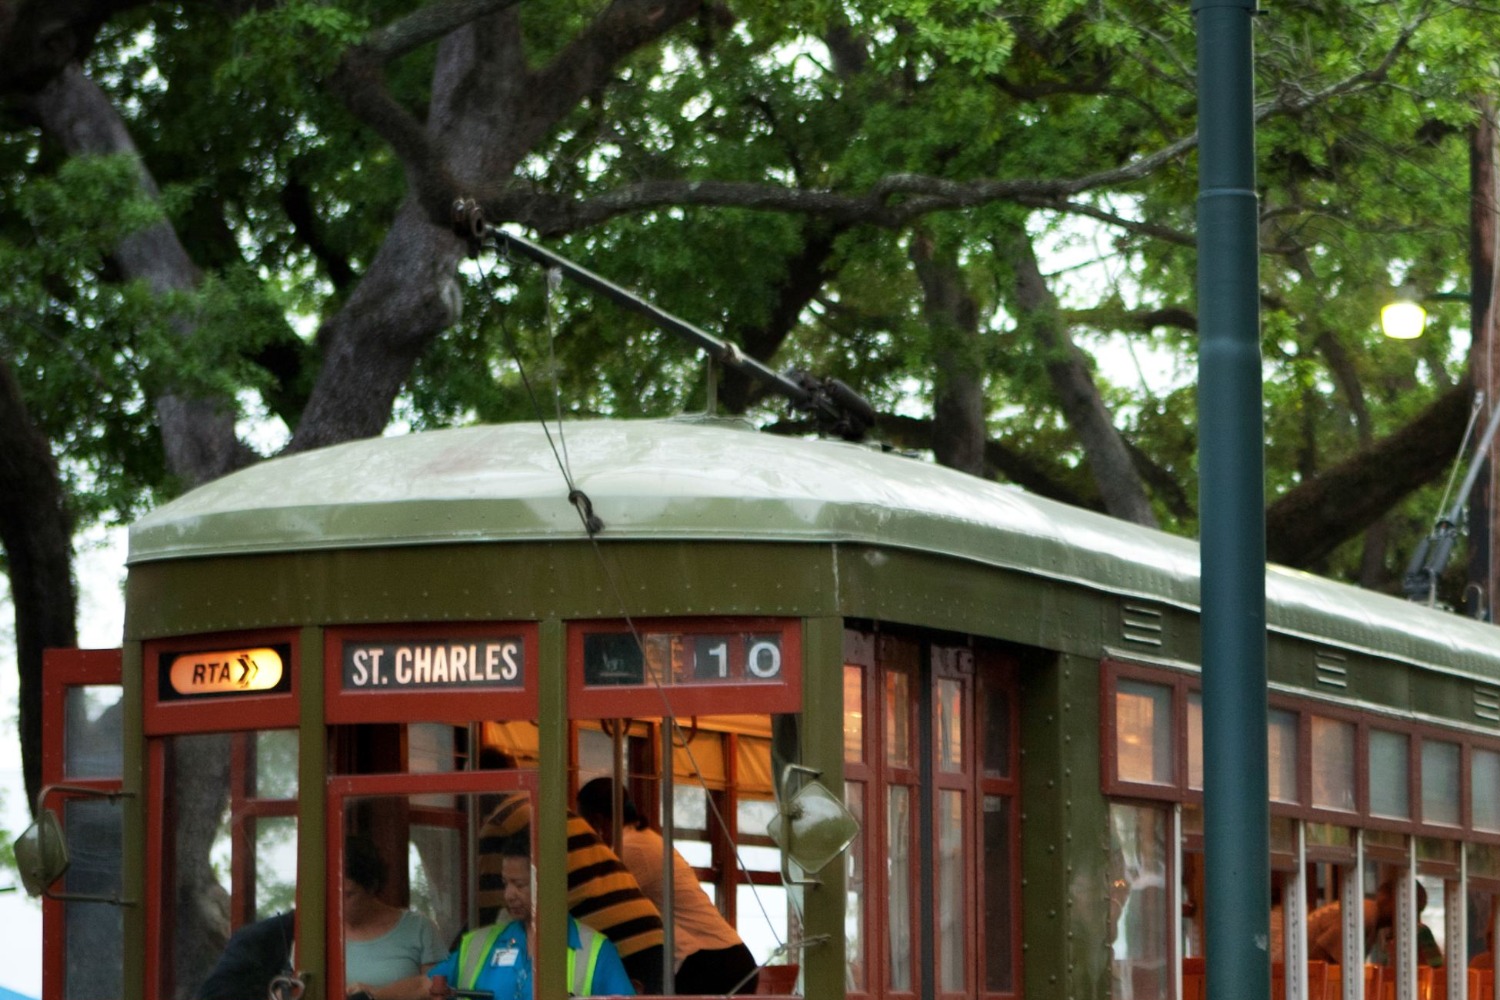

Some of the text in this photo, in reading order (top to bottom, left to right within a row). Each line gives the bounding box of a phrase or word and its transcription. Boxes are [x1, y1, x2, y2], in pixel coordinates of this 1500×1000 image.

[192, 661, 231, 685] RTA
[352, 643, 517, 686] ST. CHARLES
